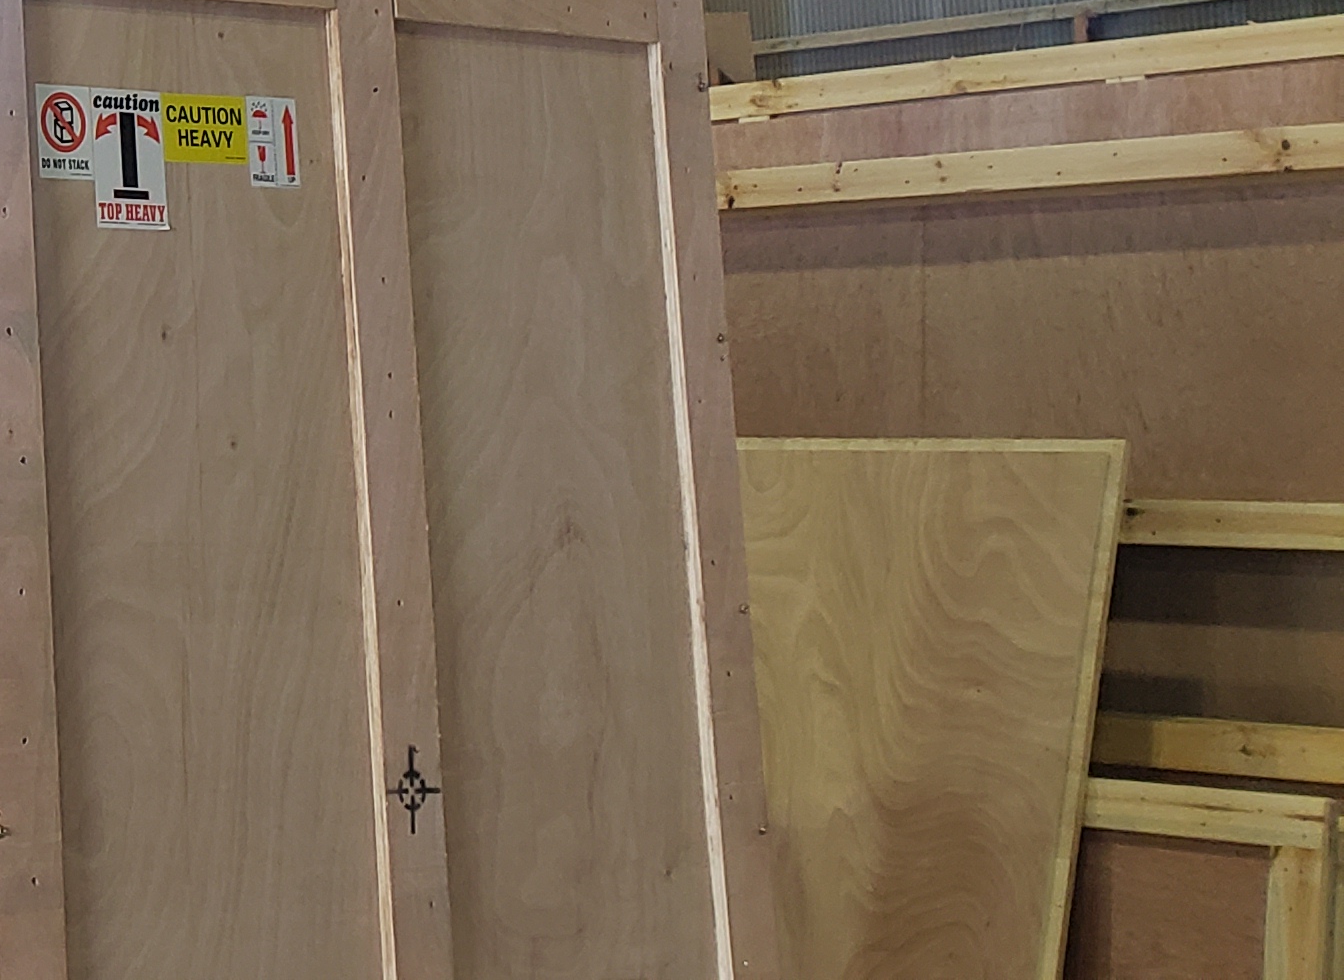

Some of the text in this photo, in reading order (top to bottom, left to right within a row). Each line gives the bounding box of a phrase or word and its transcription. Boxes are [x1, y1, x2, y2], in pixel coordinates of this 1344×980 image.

[93, 93, 160, 113] caution
[165, 104, 242, 126] CAUTION
[177, 129, 234, 149] HEAVY
[41, 157, 90, 170] DO NOT STACK
[99, 202, 165, 222] TOP HEAVY
